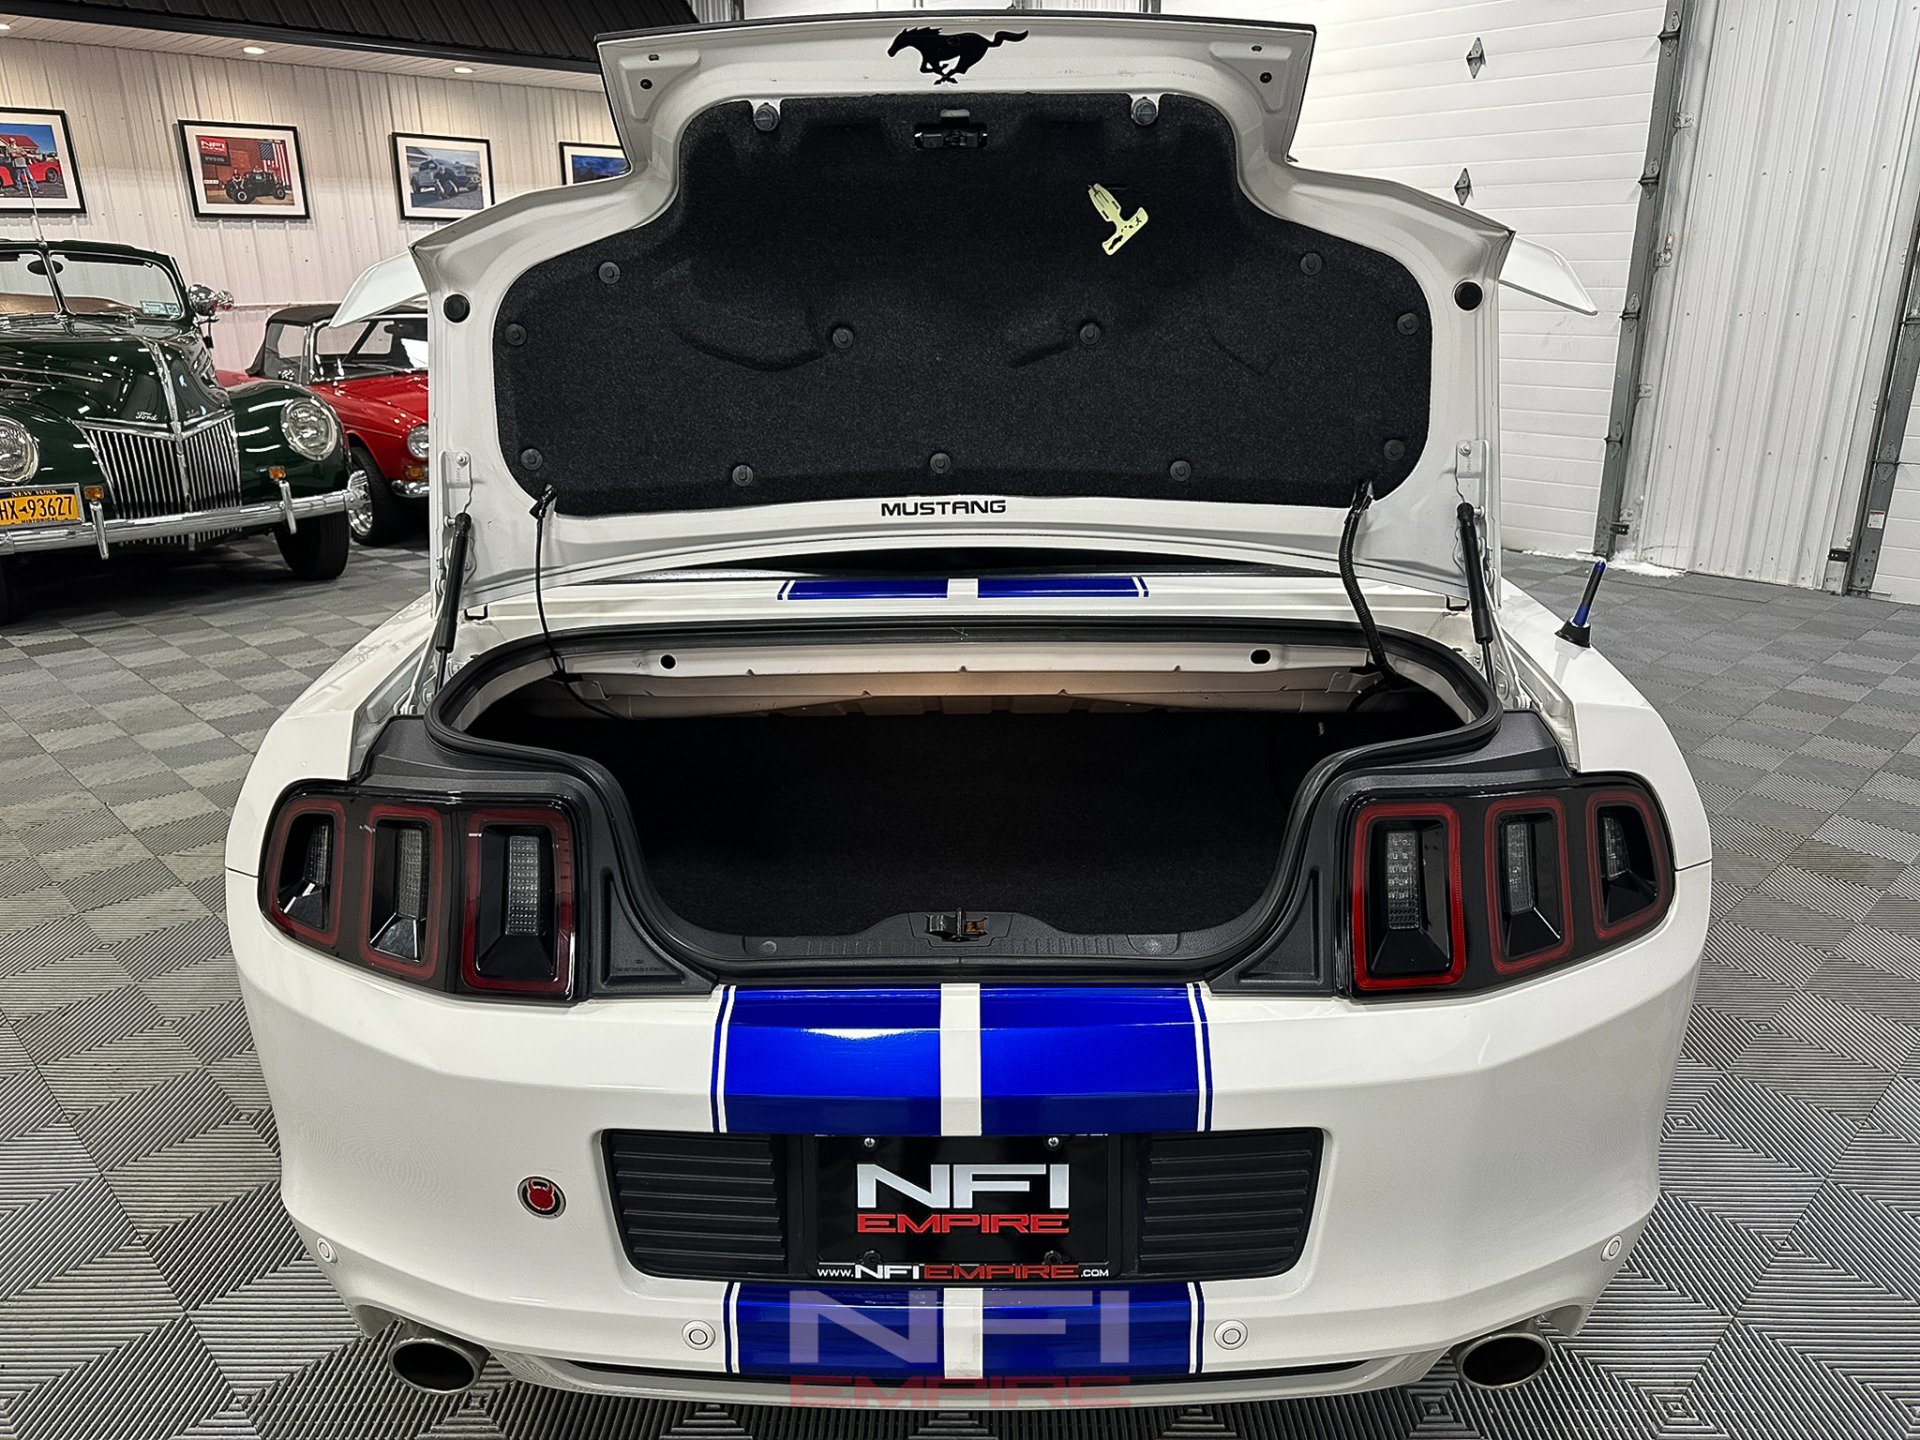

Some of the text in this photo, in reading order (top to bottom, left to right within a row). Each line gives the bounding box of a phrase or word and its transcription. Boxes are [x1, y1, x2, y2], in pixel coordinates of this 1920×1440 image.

[135, 411, 158, 421] Ford
[881, 500, 1006, 516] MUSTANG
[857, 1164, 1069, 1209] NFI
[857, 1214, 1069, 1233] EMPIRE
